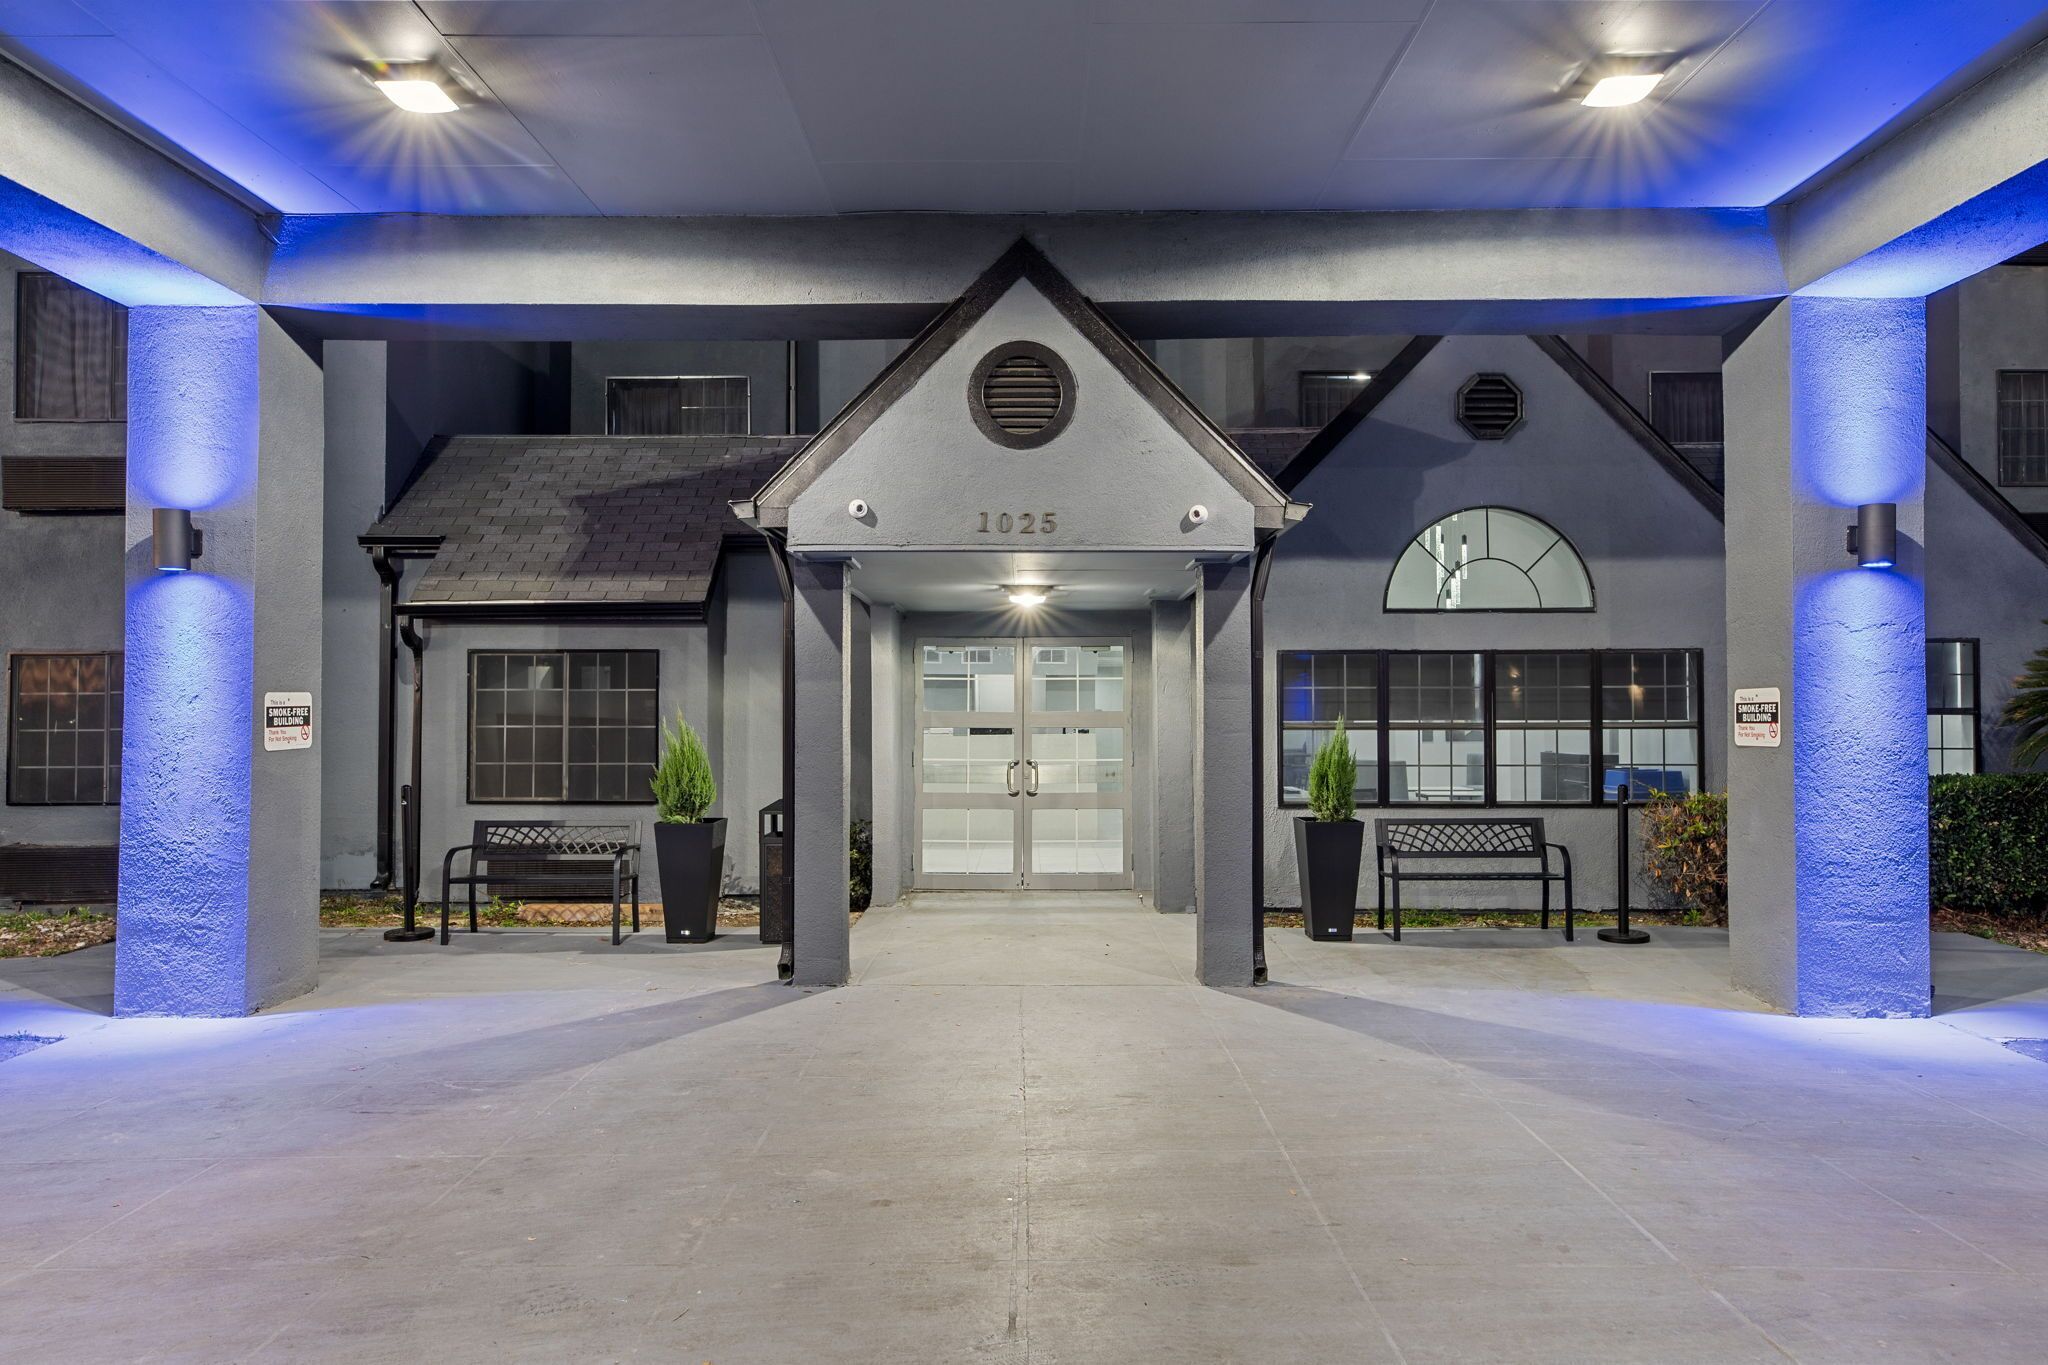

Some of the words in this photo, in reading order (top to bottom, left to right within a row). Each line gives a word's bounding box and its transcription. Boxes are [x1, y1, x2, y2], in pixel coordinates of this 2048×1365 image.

[976, 511, 1058, 534] 1025
[268, 707, 309, 717] SMOKE-FREE
[1738, 704, 1776, 712] SMOKE-FREE
[273, 716, 304, 726] BUILDING
[1742, 714, 1772, 722] BUILDING
